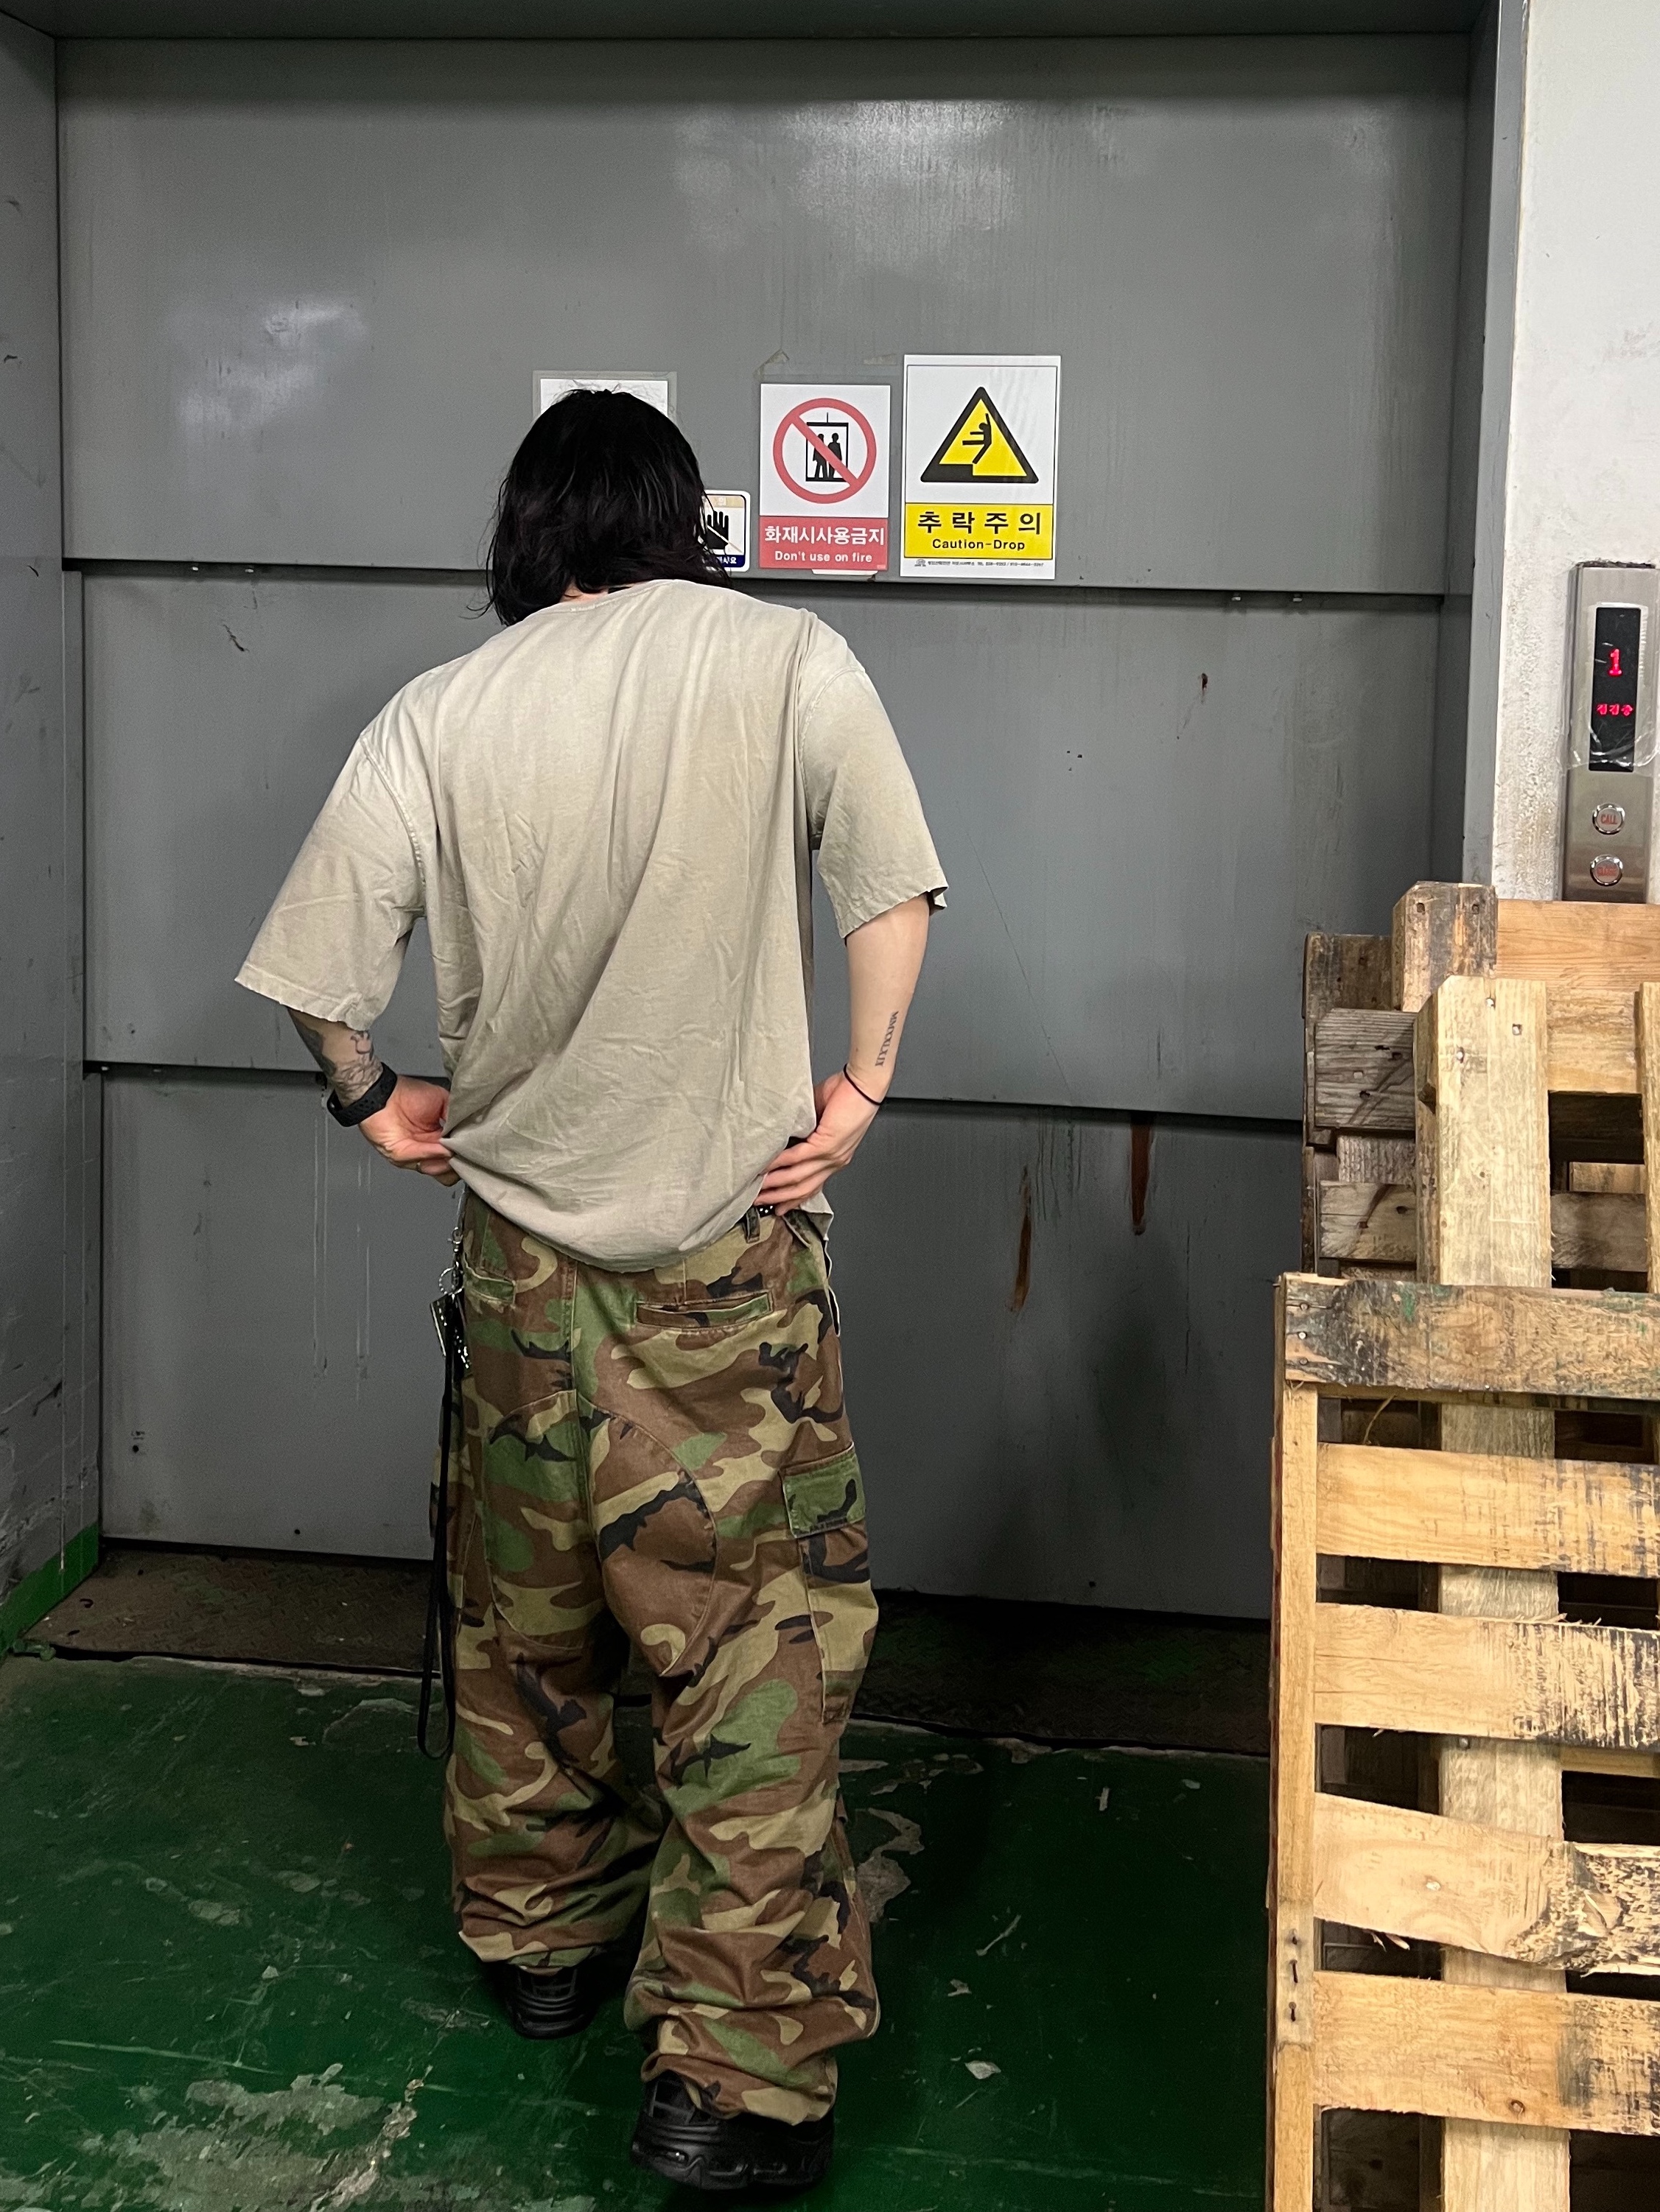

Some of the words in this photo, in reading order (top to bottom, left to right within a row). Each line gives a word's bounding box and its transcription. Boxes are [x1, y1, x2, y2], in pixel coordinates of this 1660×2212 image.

[764, 525, 885, 546] 화재시사용금지
[932, 538, 1026, 551] Caution-Drop
[774, 550, 806, 561] Don't
[809, 553, 830, 562] use
[834, 553, 849, 562] on
[852, 552, 872, 563] fire
[1608, 648, 1622, 675] 1
[1600, 814, 1618, 824] CALL
